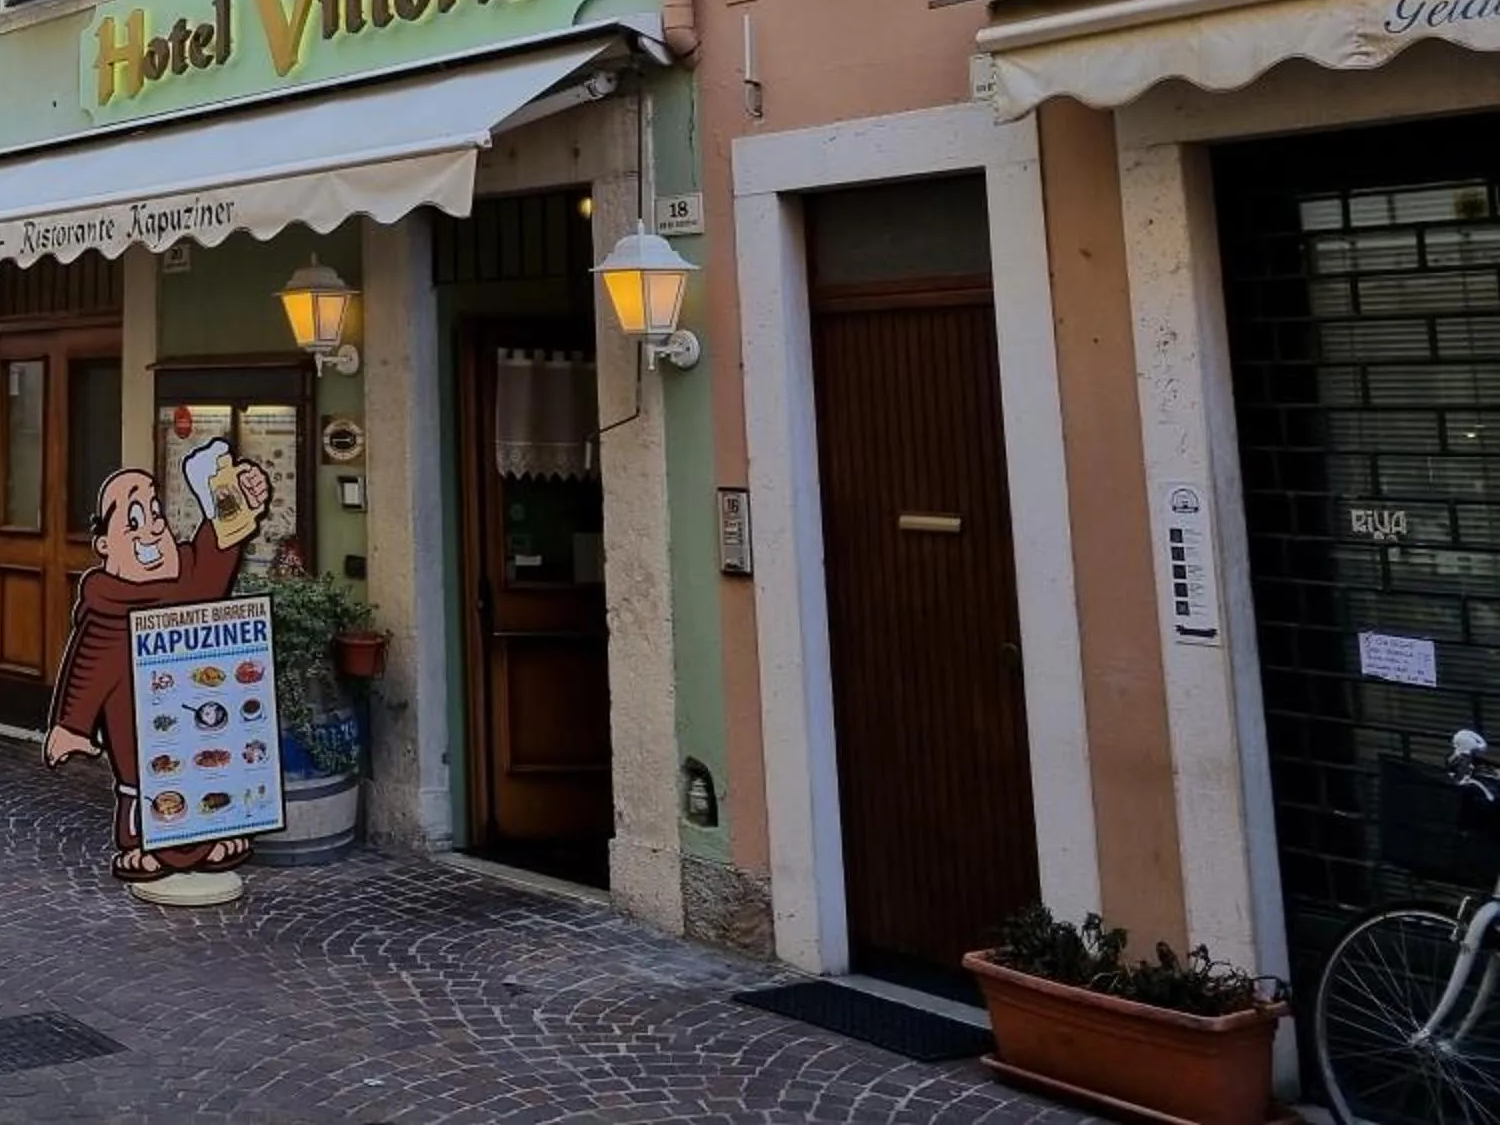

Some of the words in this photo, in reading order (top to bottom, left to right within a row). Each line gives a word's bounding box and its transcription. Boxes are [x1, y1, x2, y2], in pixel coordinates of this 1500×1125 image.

[20, 217, 115, 255] Ristorante
[126, 197, 235, 242] Kapuziner
[669, 201, 689, 218] 18
[135, 608, 208, 632] RISTORANTE
[211, 602, 266, 623] BIRRERIA
[137, 620, 267, 658] KAPUZINER
